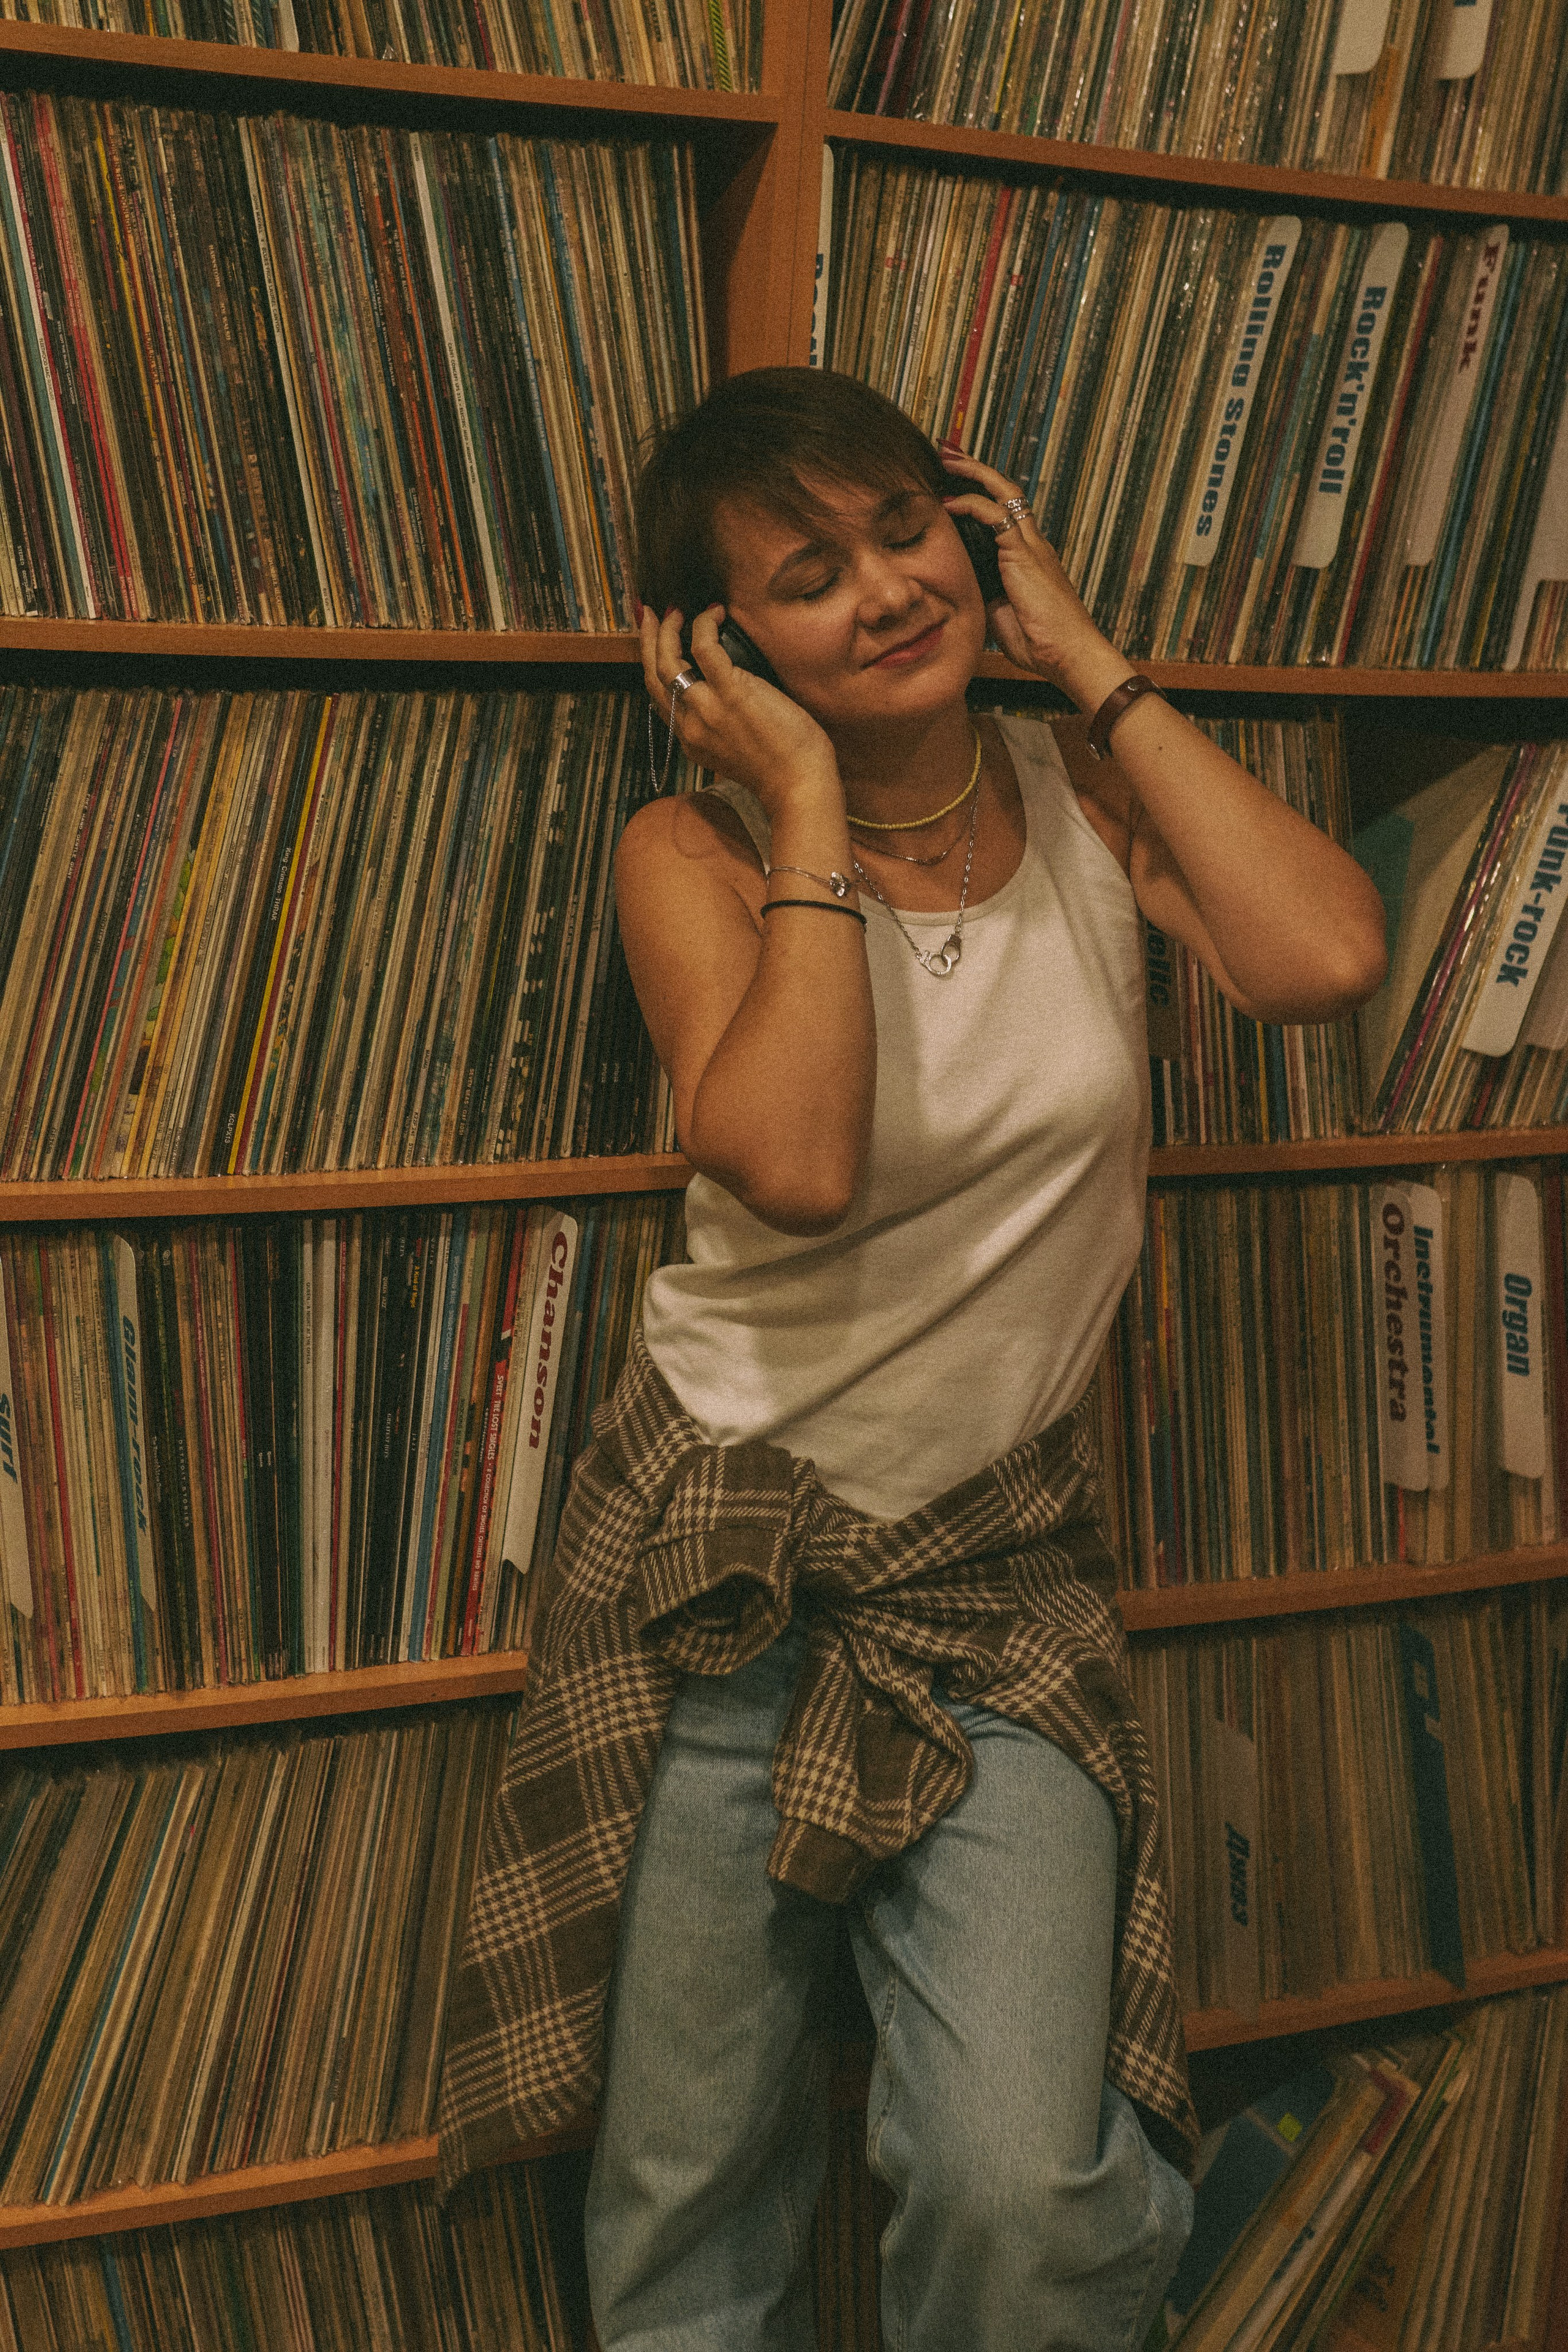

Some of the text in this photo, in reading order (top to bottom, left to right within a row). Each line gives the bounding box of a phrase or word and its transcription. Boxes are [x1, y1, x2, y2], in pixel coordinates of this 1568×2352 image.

[119, 190, 132, 234] MOONLIGHT
[268, 285, 276, 307] LAUREL
[272, 309, 281, 333] CANYON
[1459, 245, 1499, 374] Funk
[38, 338, 48, 365] FLEETWOOD
[1196, 245, 1286, 537] Rolling Stones
[1318, 287, 1387, 494] Rock'n'roll
[129, 590, 137, 610] STEREO
[359, 784, 368, 810] MAXIMUM
[72, 834, 81, 858] GENTLE
[271, 848, 291, 920] King Crimson THRAK
[224, 1113, 235, 1143] KCLPX13
[1382, 1202, 1409, 1423] Orchestra
[1502, 1273, 1531, 1377] Organ
[442, 1332, 451, 1370] COLLECTION
[529, 1230, 567, 1449] Chanson
[1413, 1226, 1440, 1454] Instrumental
[495, 1375, 503, 1395] SWEET
[123, 1314, 147, 1534] Glam-rock
[383, 1413, 393, 1442] GREATEST
[487, 1433, 496, 1460] SINGLES
[181, 1487, 190, 1526] STORIES
